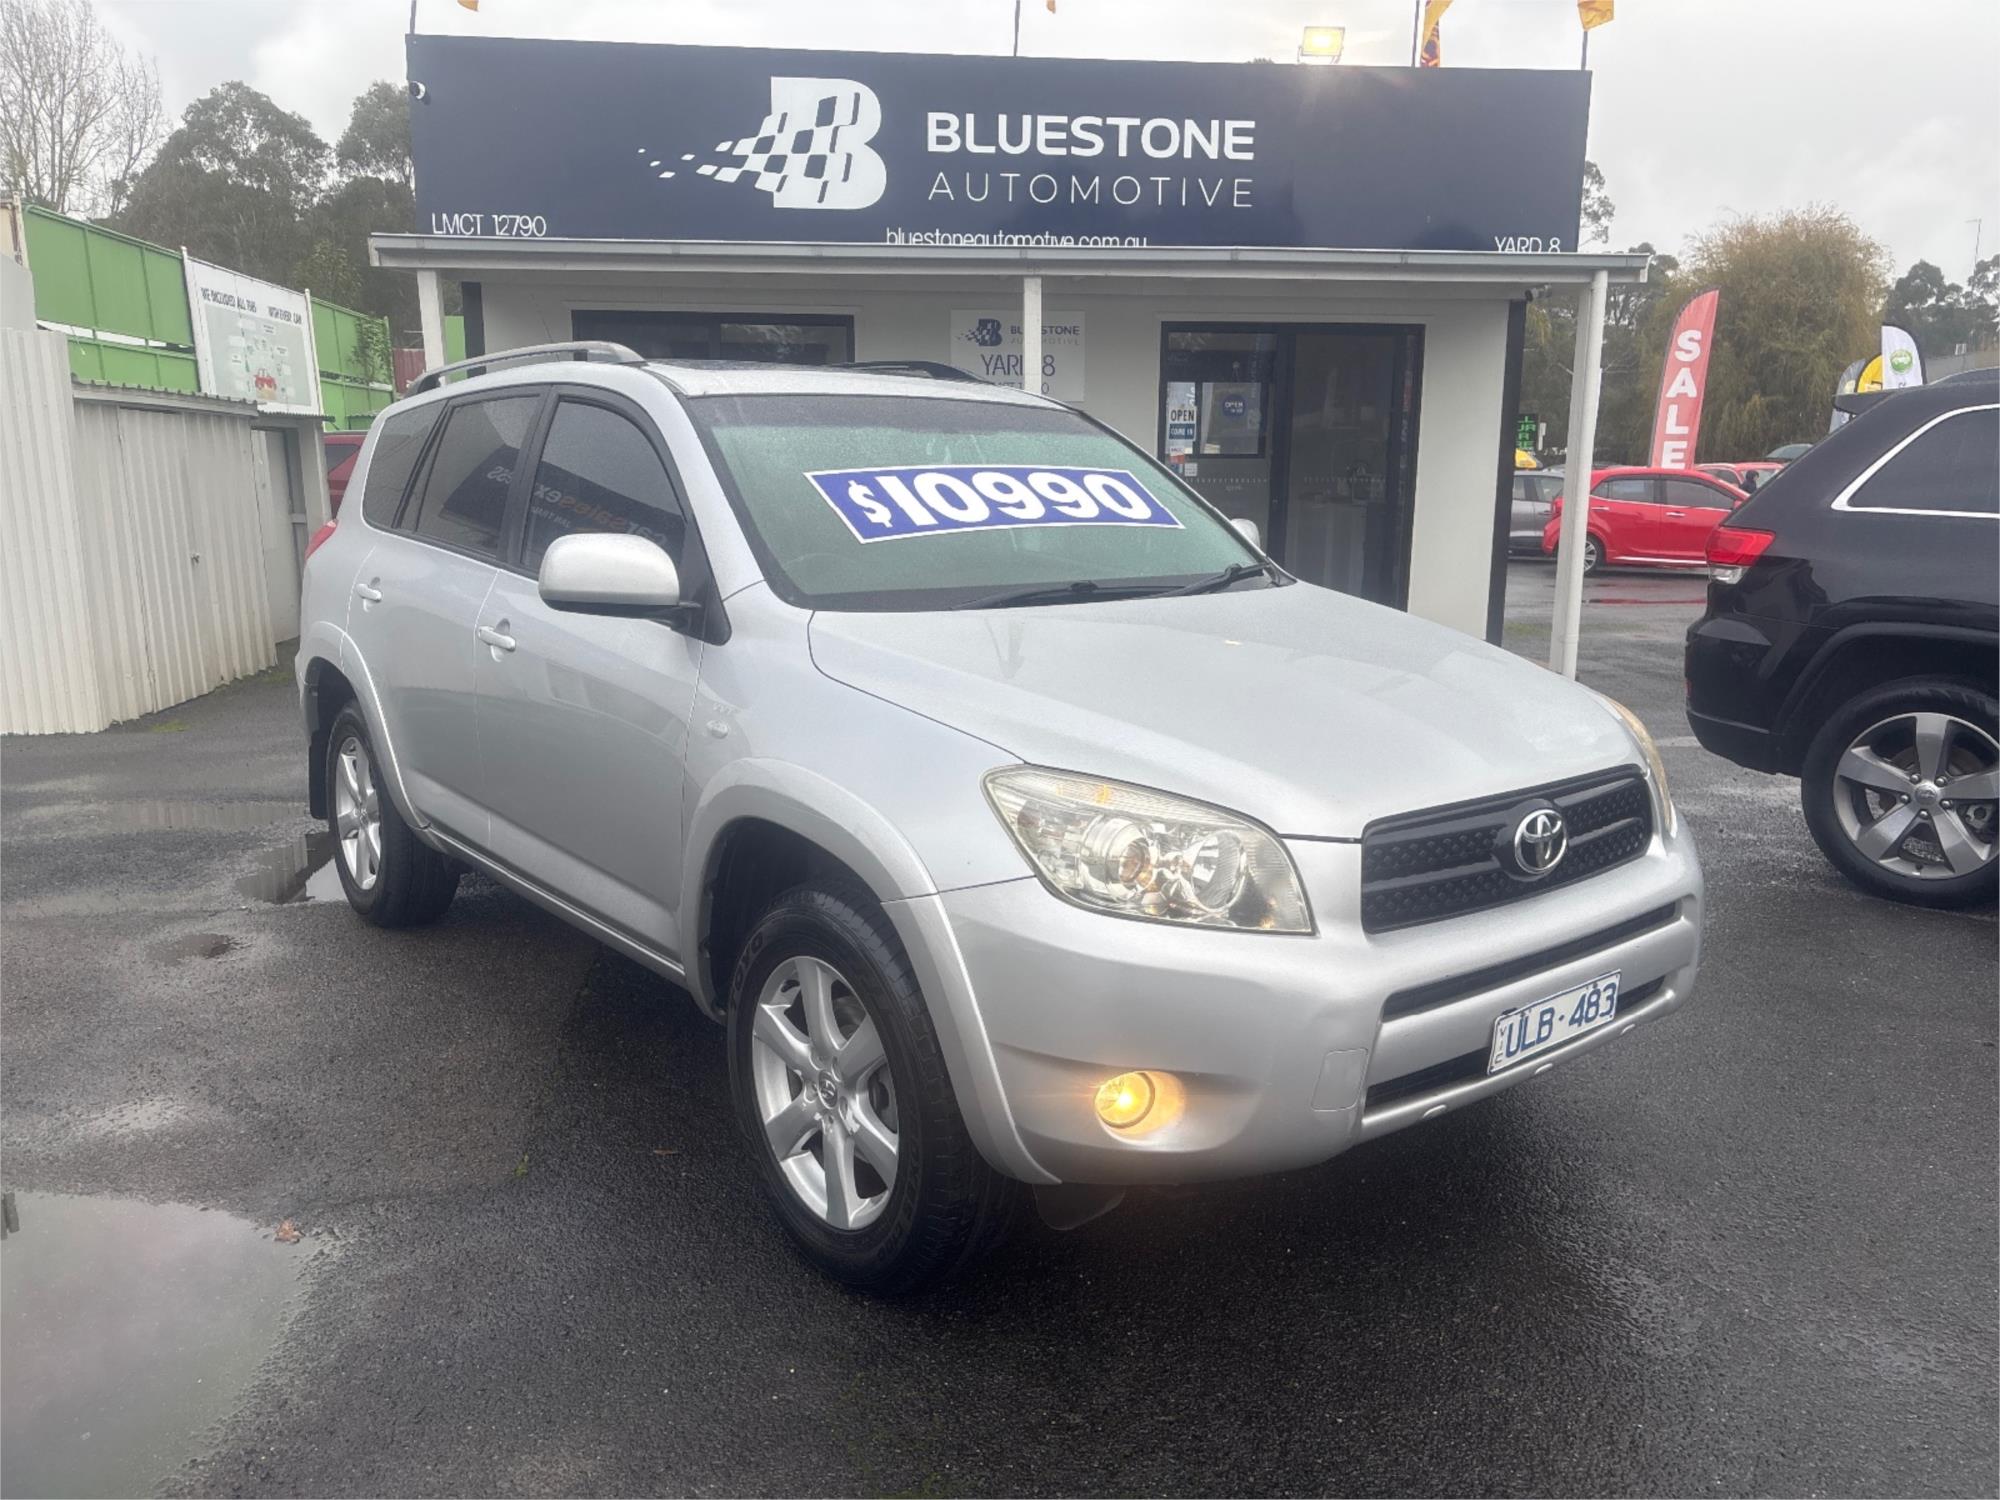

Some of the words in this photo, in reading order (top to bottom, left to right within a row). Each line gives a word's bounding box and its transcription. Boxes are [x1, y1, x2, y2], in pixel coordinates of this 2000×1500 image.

[926, 111, 1256, 161] BLUESTONE
[928, 171, 1253, 208] AUTOMOTIVE
[431, 212, 484, 236] LMCT
[492, 214, 547, 238] 12790
[1494, 236, 1542, 253] YARD
[1549, 237, 1561, 253] 8
[1010, 325, 1080, 335] BLSTONE
[980, 353, 1024, 376] YAR
[1042, 354, 1055, 377] 8
[1661, 329, 1702, 470] SALE
[1170, 409, 1195, 422] OPEN
[847, 471, 1152, 528] $10990
